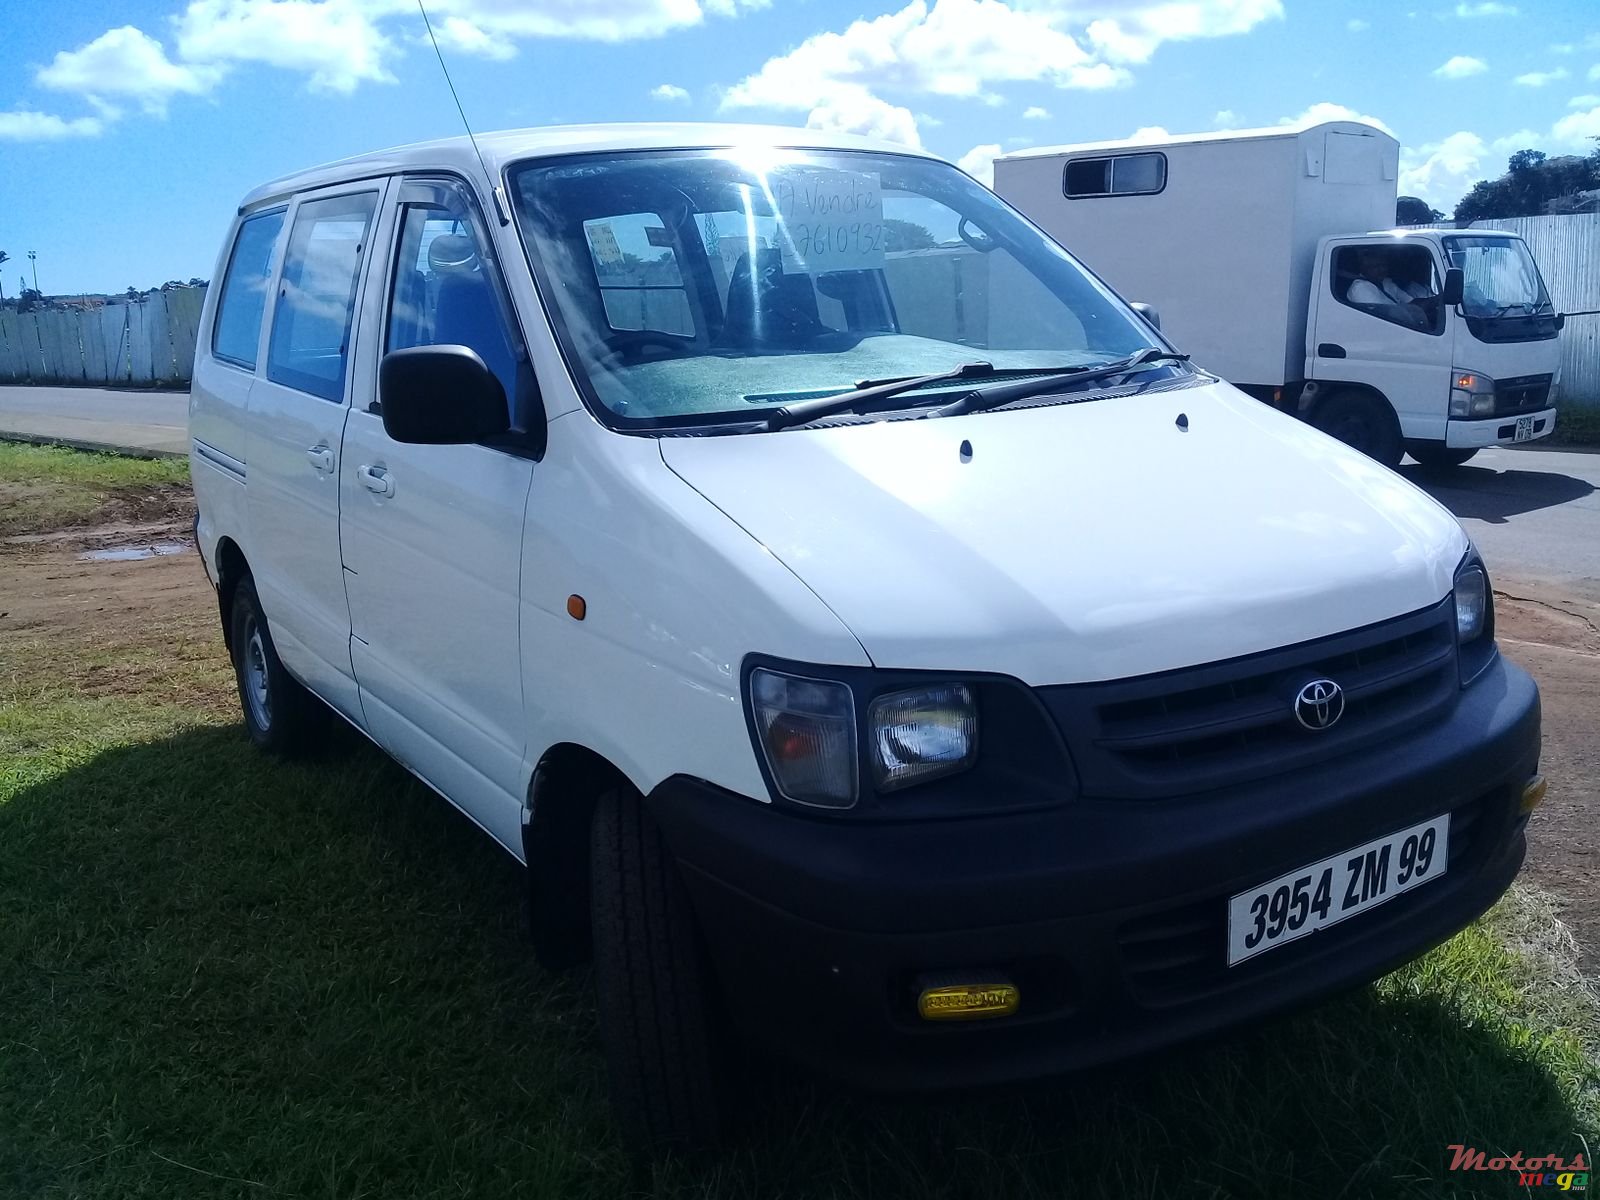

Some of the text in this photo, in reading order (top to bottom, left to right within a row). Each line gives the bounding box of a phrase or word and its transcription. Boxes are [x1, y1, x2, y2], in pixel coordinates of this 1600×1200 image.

[806, 177, 878, 215] Vendre
[1245, 827, 1436, 949] 3954 ZM 99
